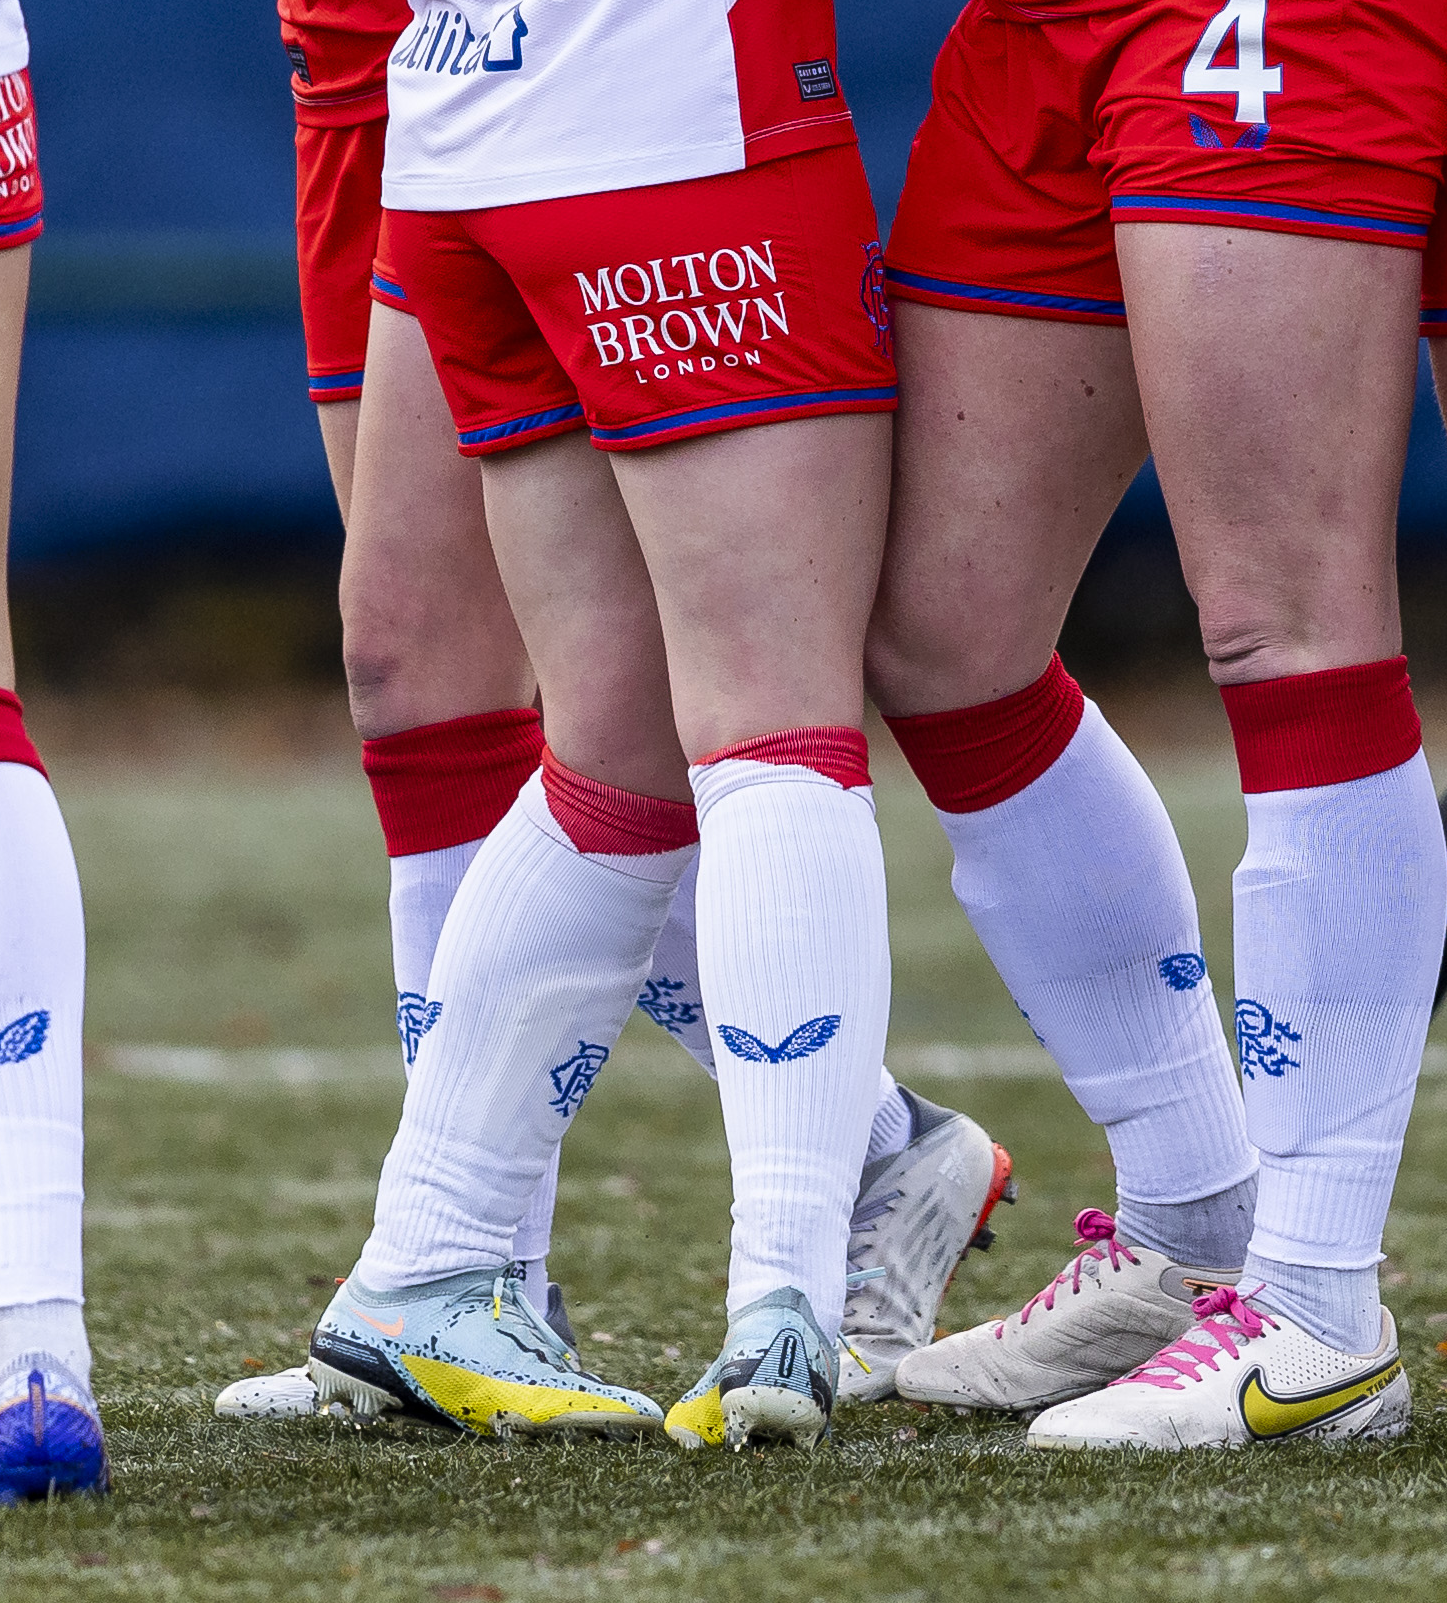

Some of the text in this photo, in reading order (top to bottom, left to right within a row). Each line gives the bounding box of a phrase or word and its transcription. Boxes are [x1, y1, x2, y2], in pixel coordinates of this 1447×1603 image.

[573, 240, 778, 315] MOLTON
[587, 291, 790, 367] BROWN
[634, 349, 762, 385] LONDON
